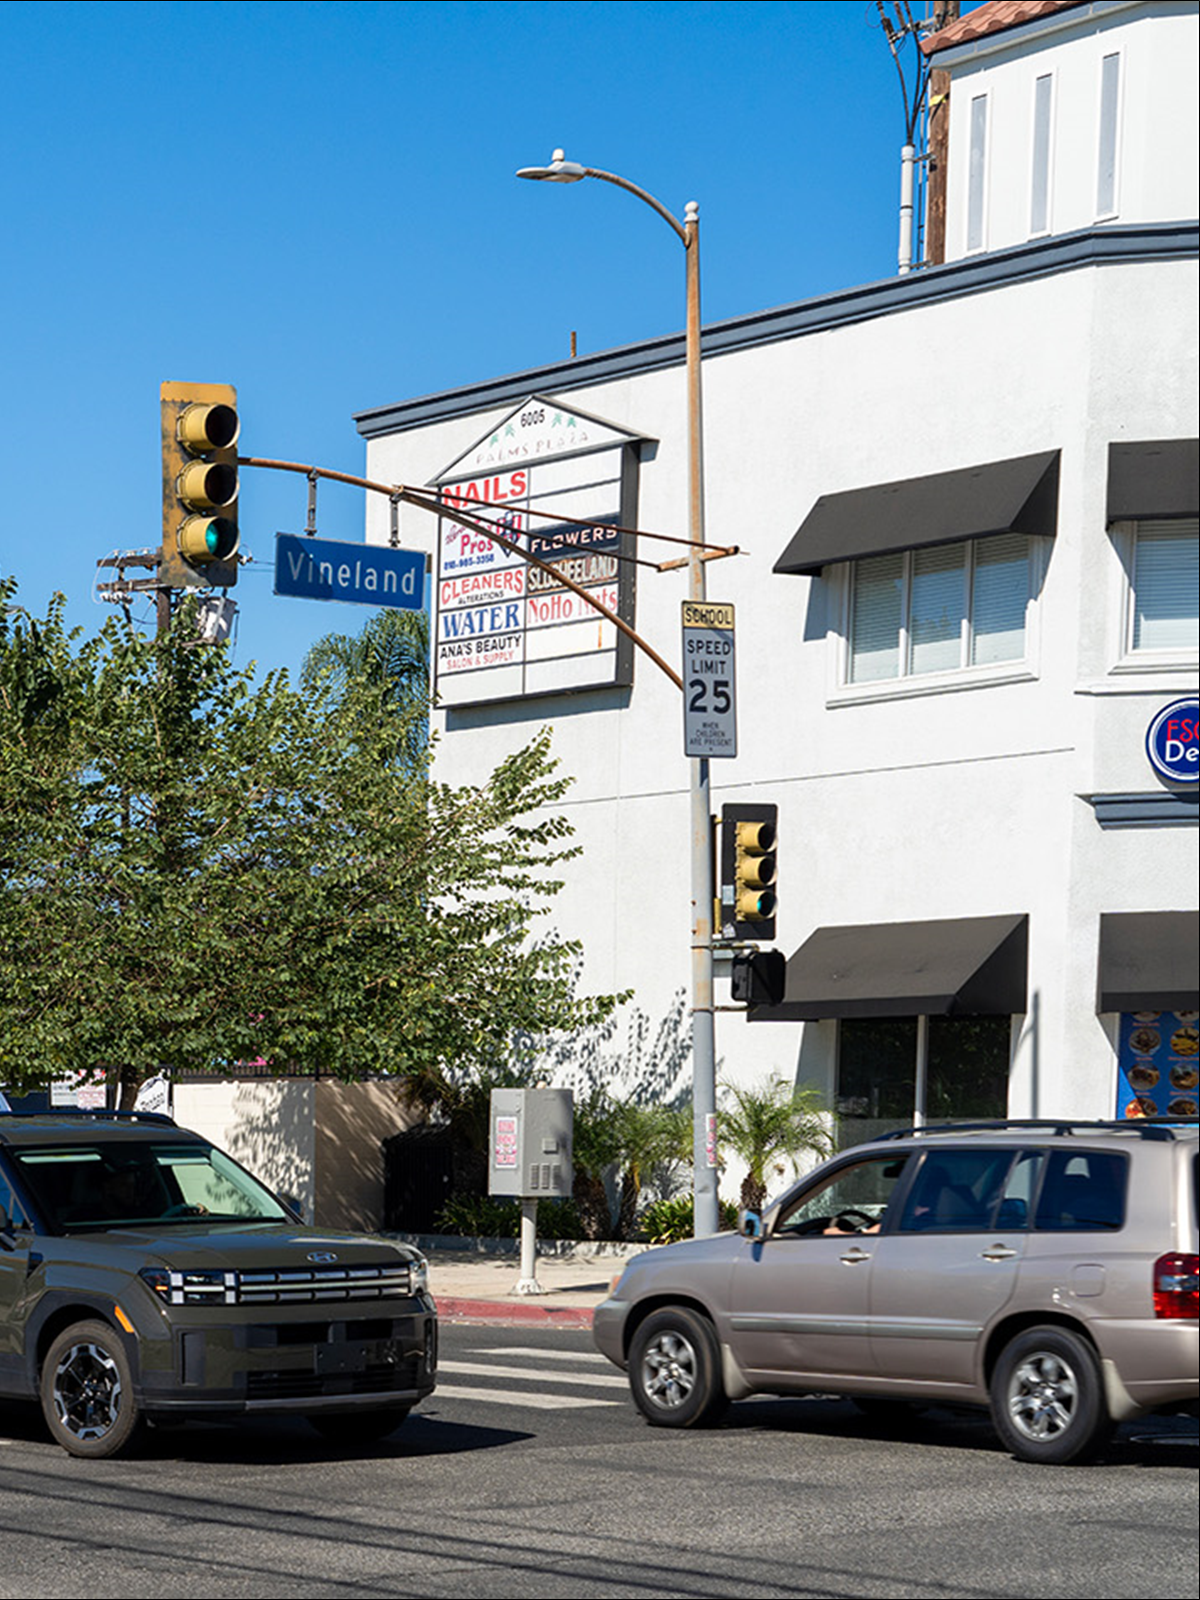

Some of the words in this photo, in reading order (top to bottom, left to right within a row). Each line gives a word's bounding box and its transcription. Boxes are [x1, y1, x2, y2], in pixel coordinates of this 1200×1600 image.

[520, 408, 546, 428] 6005
[443, 471, 527, 509] NAILS
[460, 534, 494, 556] Pros
[531, 524, 618, 553] FLOWERS
[287, 551, 416, 595] Vineland
[441, 569, 523, 605] CLEANERS
[458, 590, 504, 604] ALTERATIONS
[442, 603, 520, 638] WATER
[527, 595, 573, 624] NoHo
[684, 607, 732, 625] SCHOOL
[440, 642, 473, 659] ANA'S
[475, 634, 522, 654] BEAUTY
[687, 639, 731, 656] SPEED
[446, 656, 473, 670] SALON
[483, 650, 514, 665] SUPPLY
[692, 659, 726, 675] LIMIT
[688, 678, 732, 714] 25
